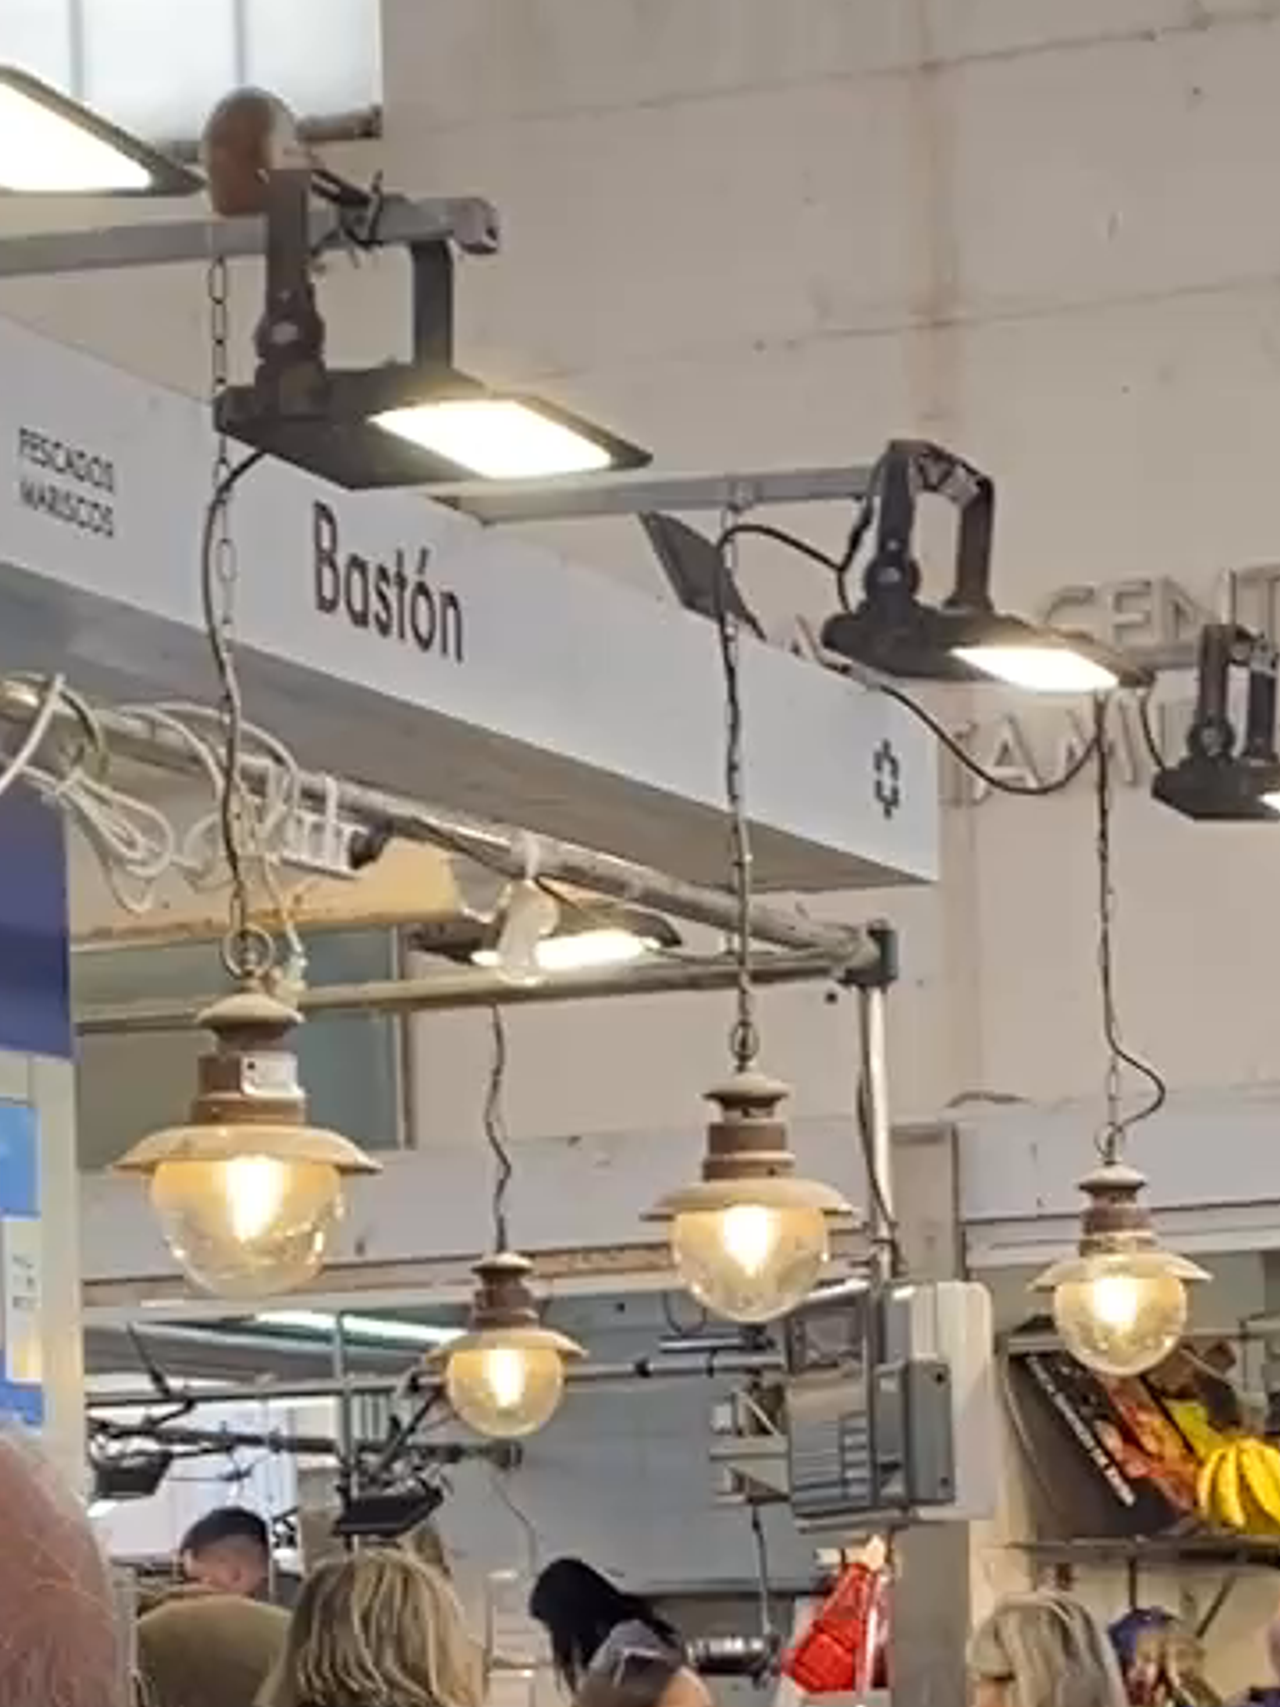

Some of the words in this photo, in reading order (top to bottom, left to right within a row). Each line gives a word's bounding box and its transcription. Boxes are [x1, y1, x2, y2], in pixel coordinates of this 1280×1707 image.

[19, 427, 114, 493] PESCADOS
[19, 478, 114, 537] MARISCOS
[313, 499, 463, 664] Bastón
